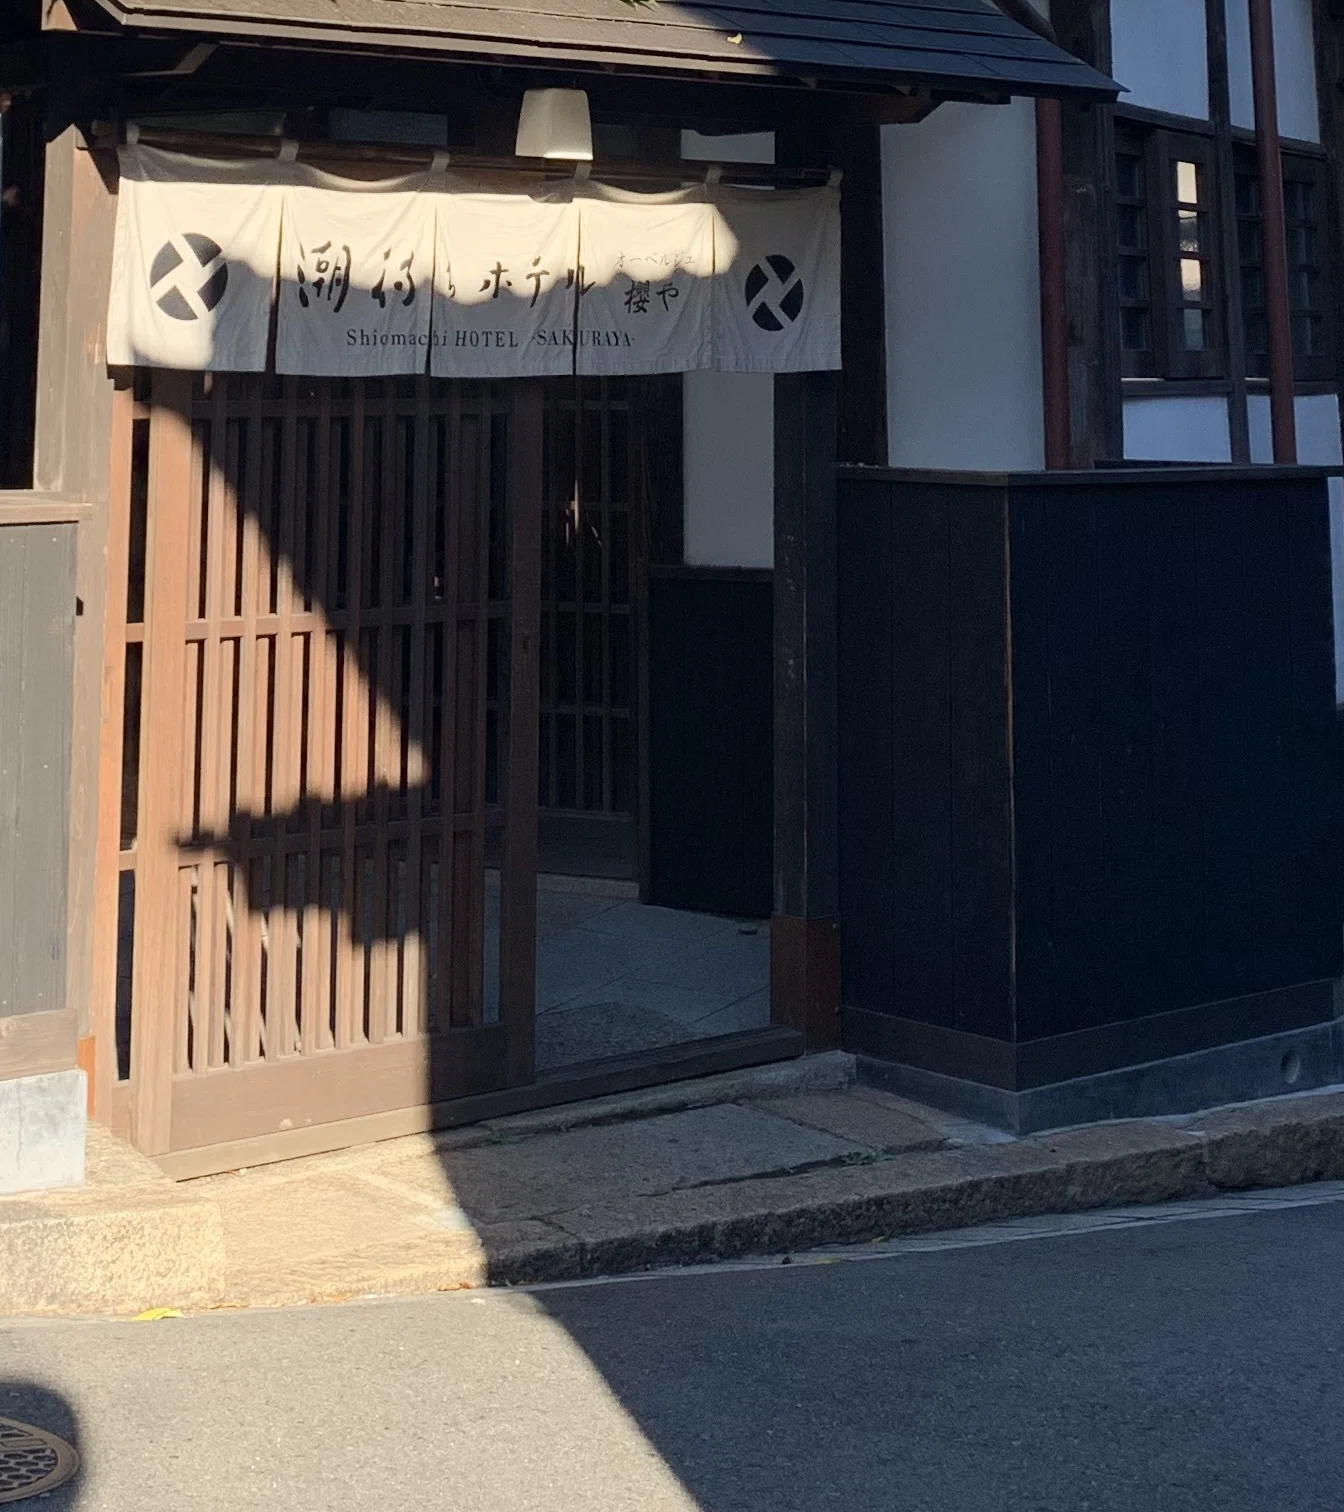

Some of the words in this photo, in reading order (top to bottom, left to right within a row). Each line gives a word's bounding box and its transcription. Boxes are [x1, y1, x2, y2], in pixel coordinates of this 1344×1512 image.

[615, 251, 696, 268] オーベルジュ
[297, 240, 596, 313] 潮待ちホテル
[624, 279, 679, 314] 櫻や
[347, 328, 447, 346] Shiomachi
[455, 329, 519, 347] HOTEL
